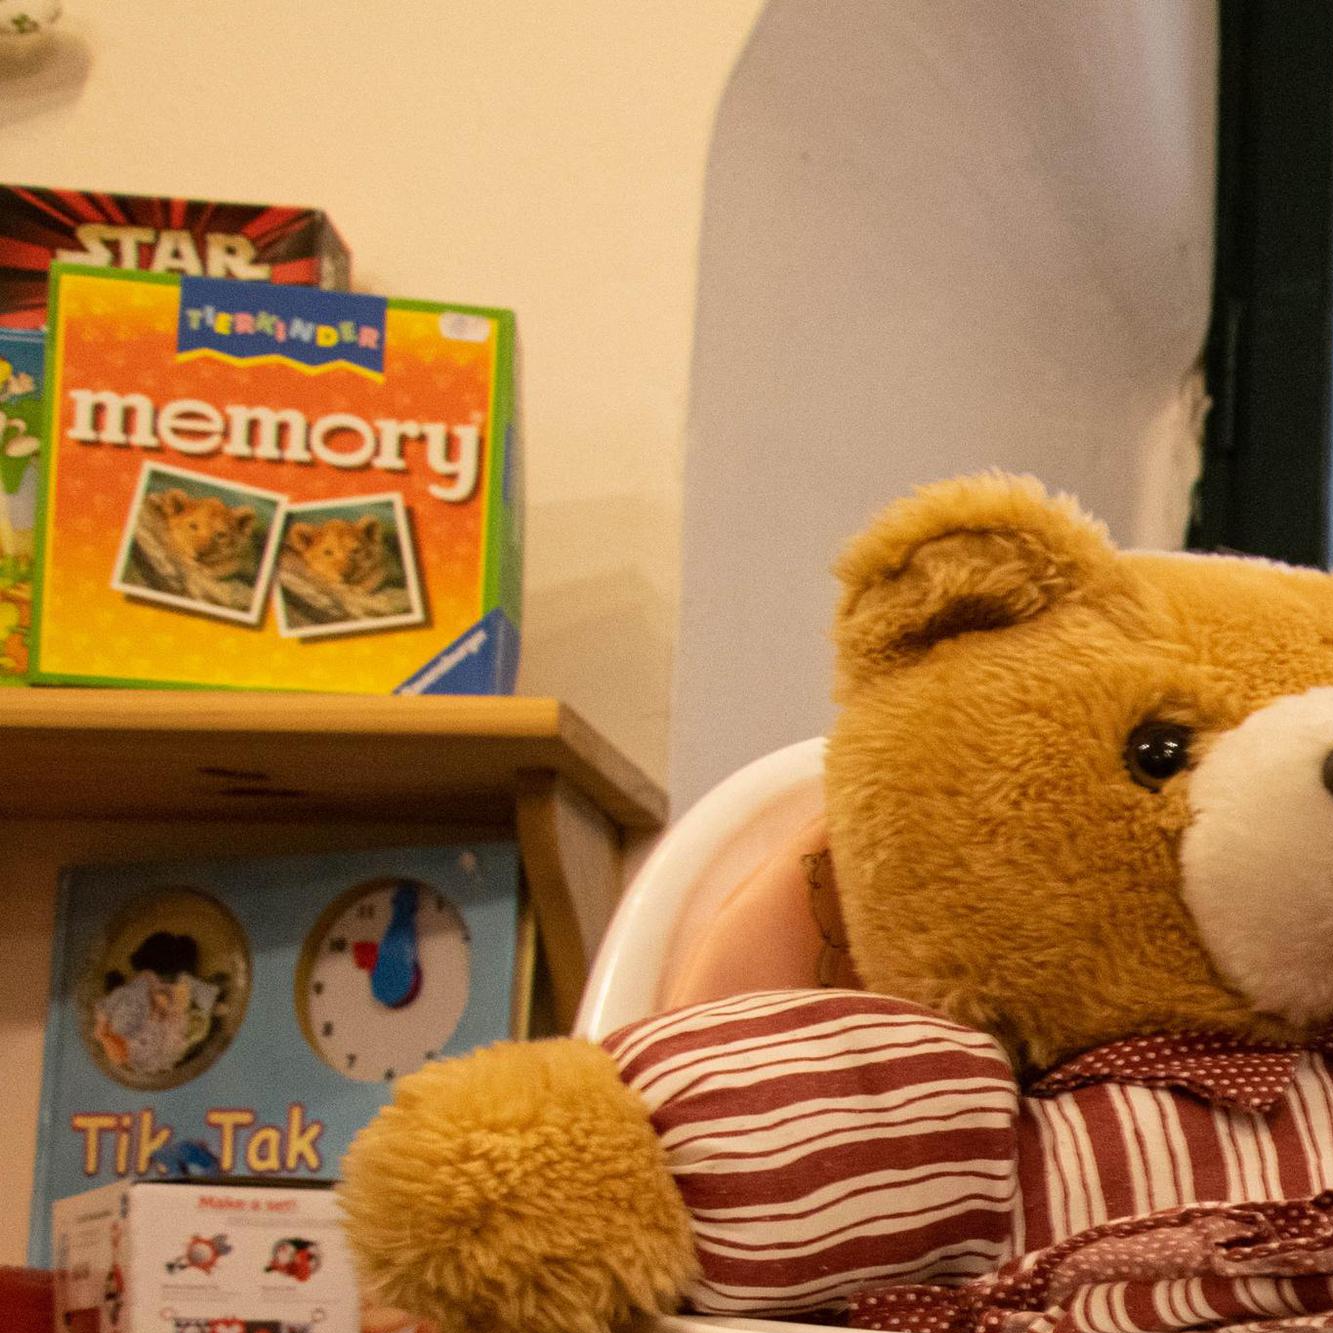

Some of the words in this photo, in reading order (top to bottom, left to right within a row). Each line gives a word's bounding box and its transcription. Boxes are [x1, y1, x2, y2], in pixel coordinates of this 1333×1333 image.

[54, 222, 272, 281] STAR
[186, 305, 380, 350] TIERKINDER
[67, 388, 481, 502] memory
[71, 1107, 173, 1177] Tik
[205, 1102, 324, 1174] Tak
